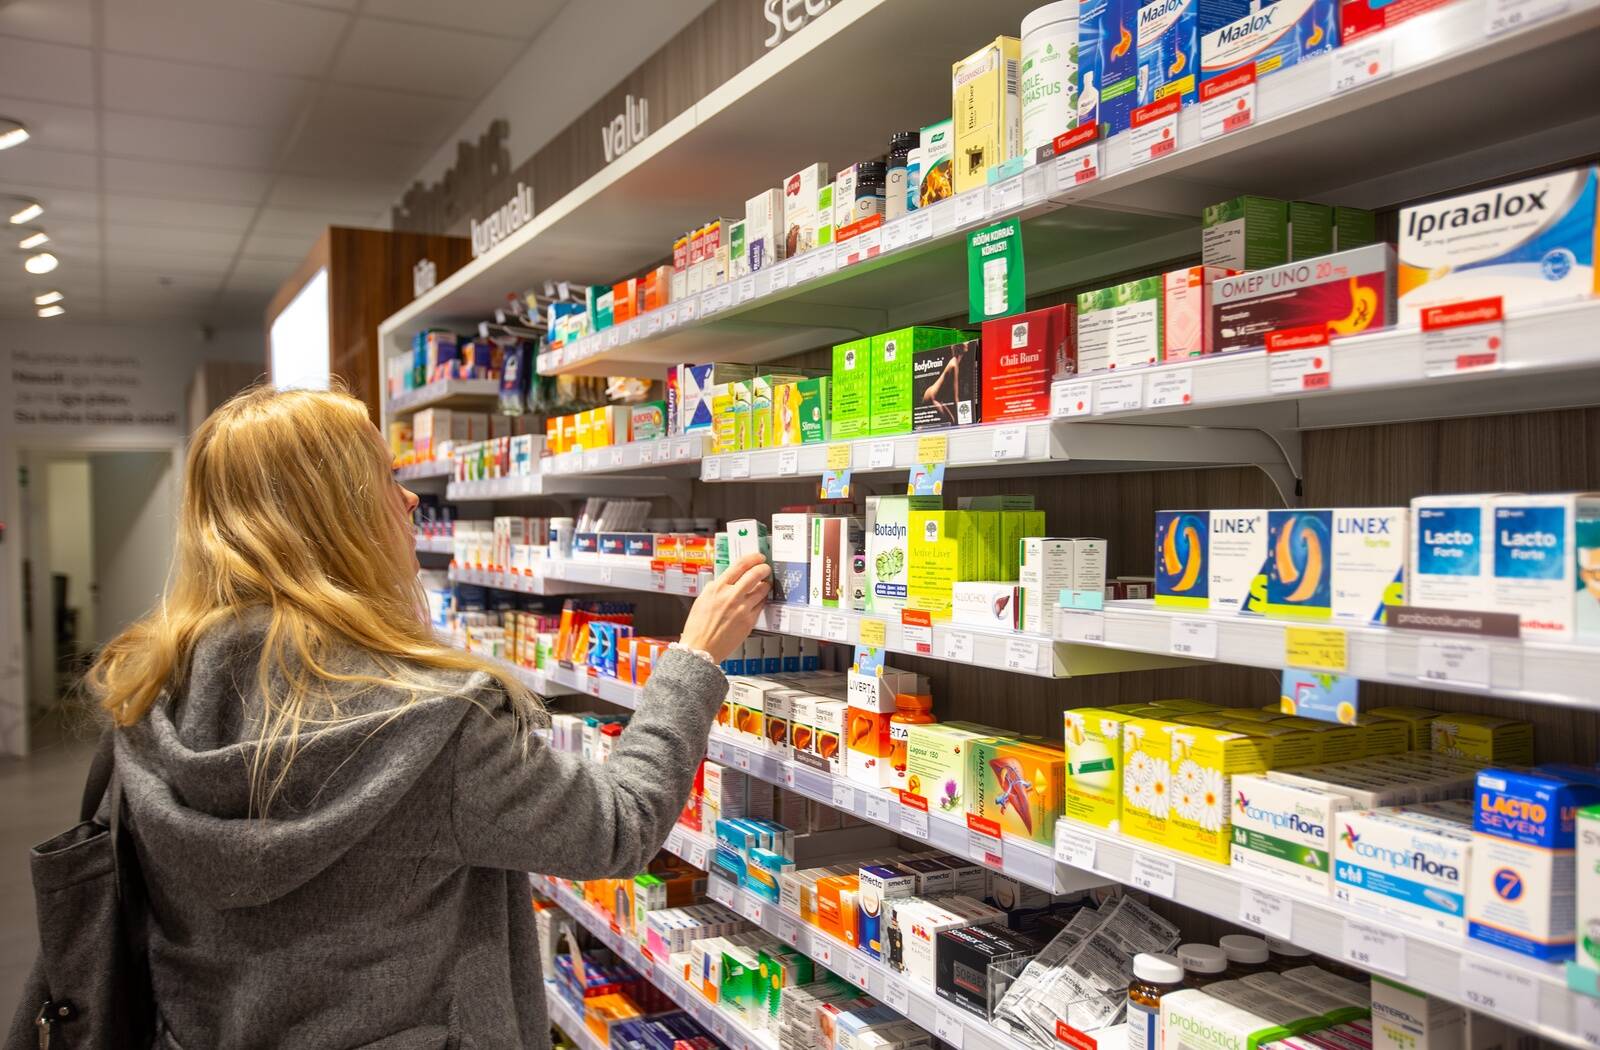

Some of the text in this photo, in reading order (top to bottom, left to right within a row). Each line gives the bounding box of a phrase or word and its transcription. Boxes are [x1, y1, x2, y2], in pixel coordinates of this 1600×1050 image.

[1217, 5, 1278, 48] Maalox
[602, 95, 648, 163] valu
[1408, 190, 1548, 241] Ipraalox
[1221, 276, 1264, 301] OMEP
[1271, 266, 1310, 290] UNO
[1315, 262, 1332, 279] 20
[914, 359, 943, 376] BodyDrain
[874, 523, 907, 541] Botadyn
[1213, 518, 1255, 534] LINEX
[1337, 517, 1390, 534] LINEX
[1424, 529, 1474, 546] Lacto
[1501, 530, 1557, 547] Lacto
[1433, 548, 1464, 558] Forte
[1511, 549, 1546, 560] Forte
[849, 678, 876, 694] LIVERTA
[867, 696, 876, 706] XR
[909, 744, 939, 762] Lagosa 150
[977, 748, 986, 819] MAKS-STRON
[1481, 793, 1546, 823] LACTO
[1247, 808, 1325, 844] compliflora
[1480, 810, 1545, 838] SEVEN
[958, 868, 982, 877] smecta
[1356, 842, 1460, 886] compliflora
[860, 872, 883, 889] smecta
[888, 879, 912, 890] smecta
[926, 873, 950, 884] smecta
[1500, 872, 1519, 898] 7
